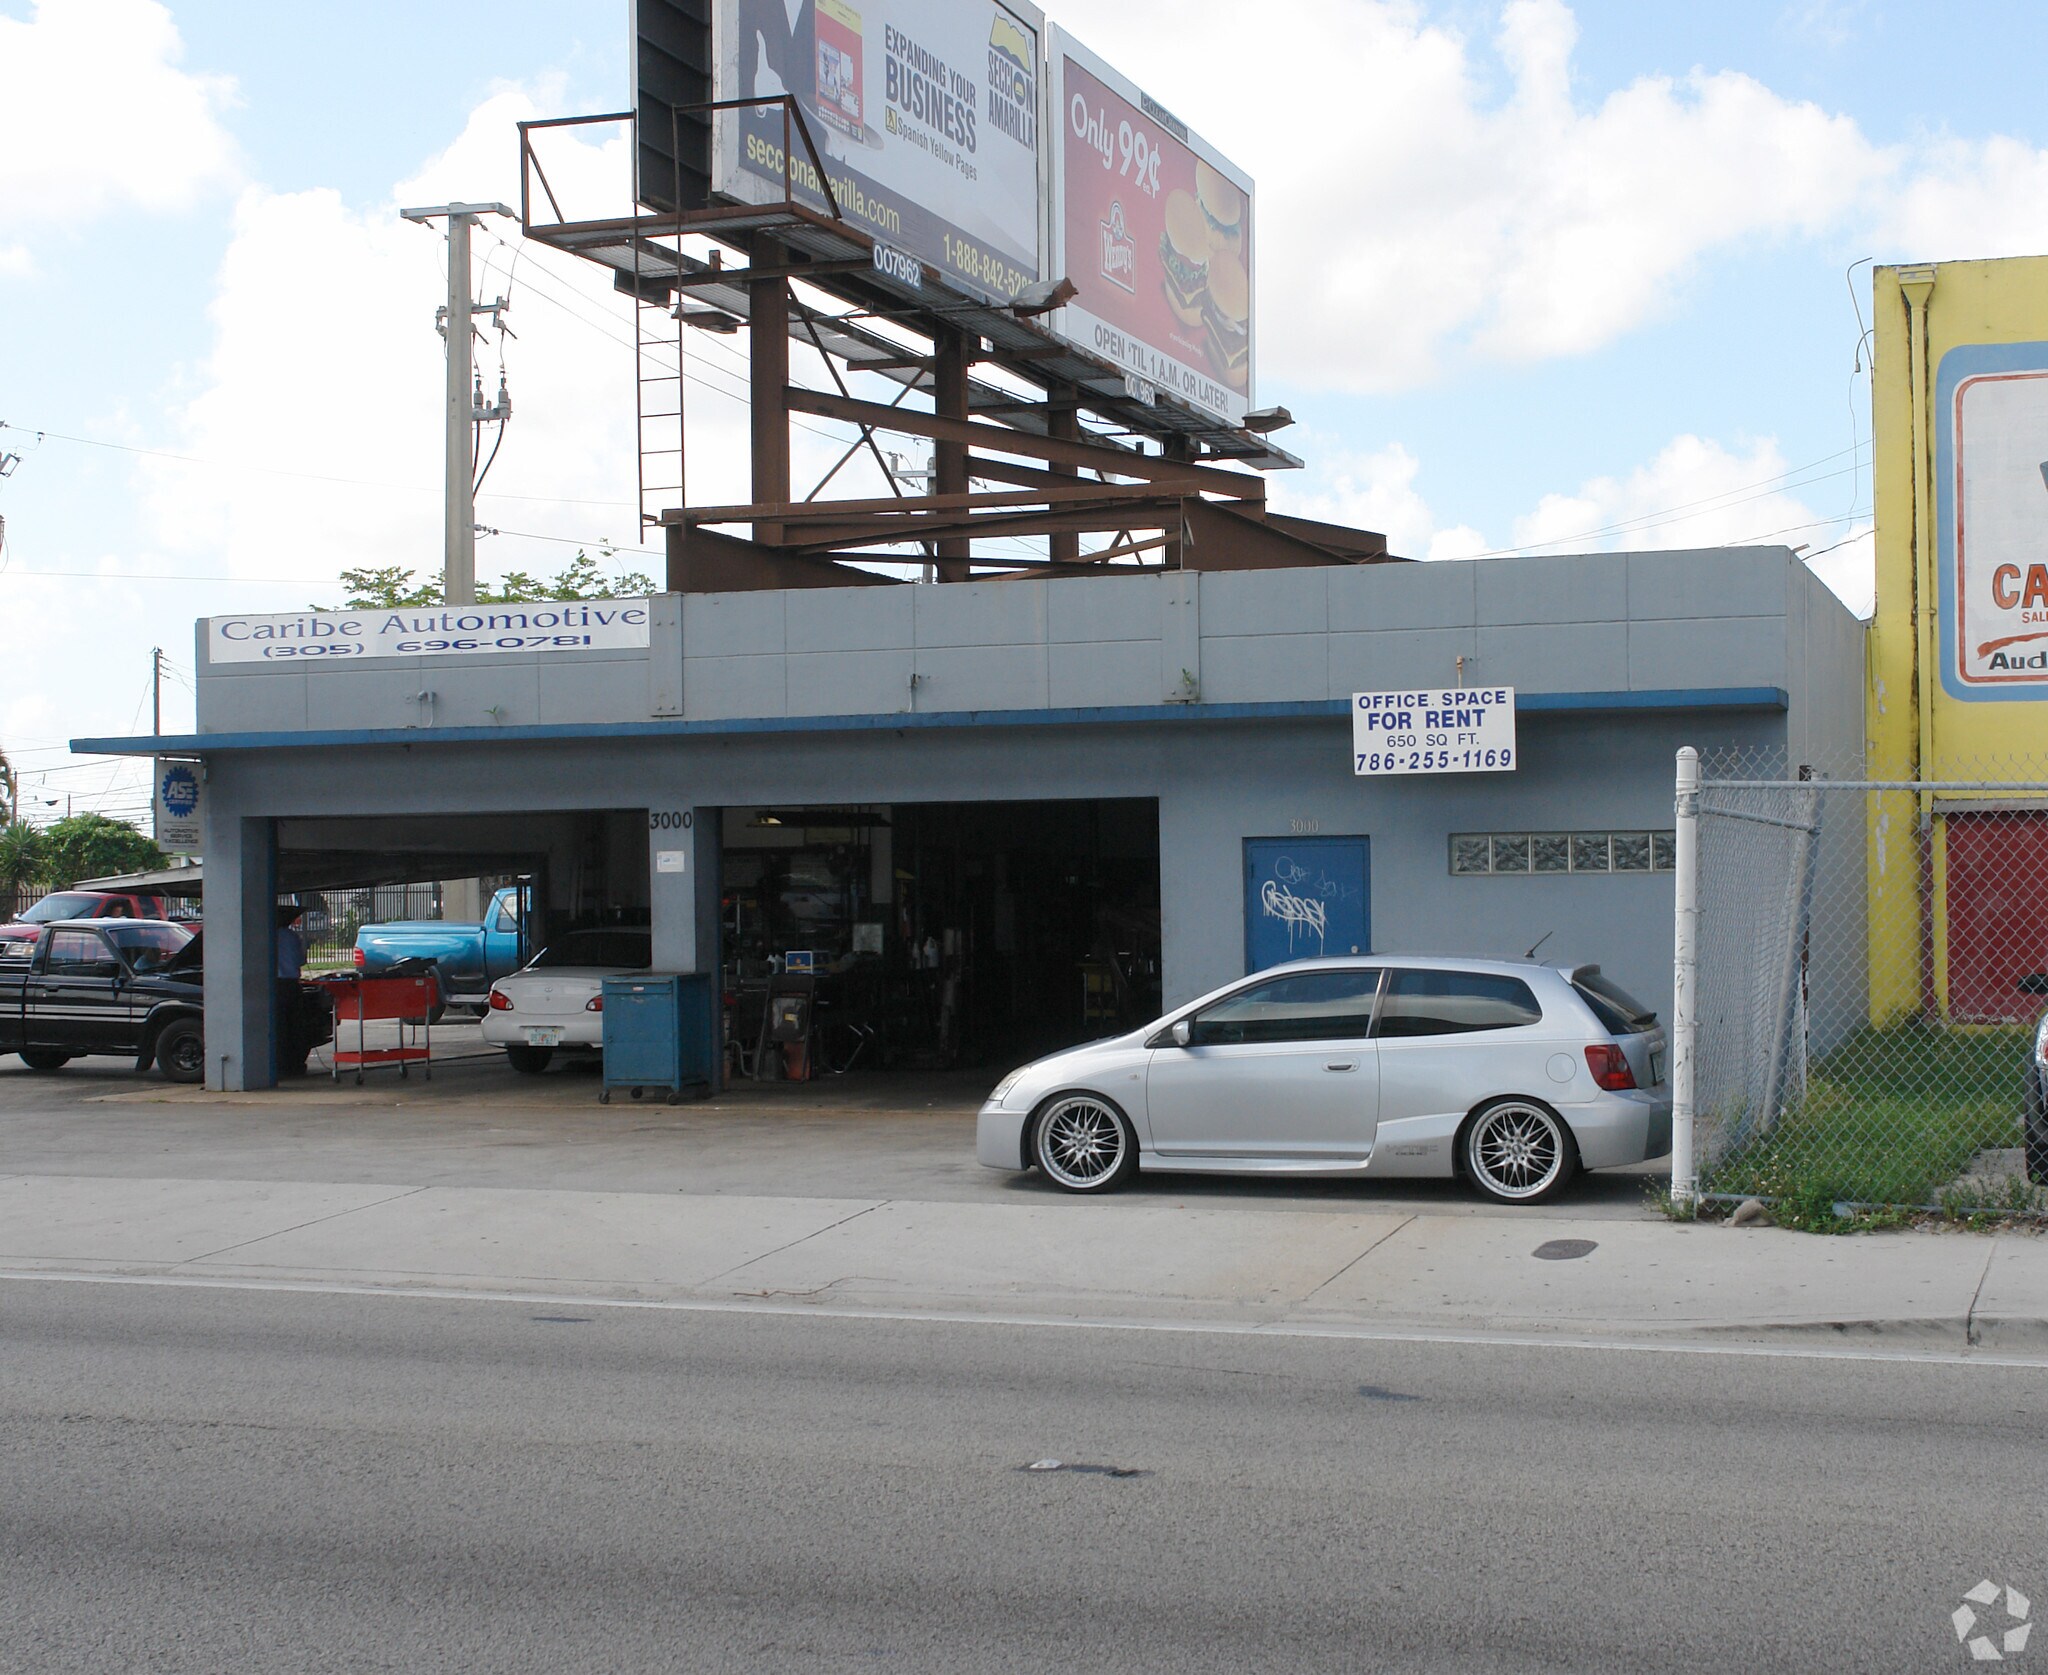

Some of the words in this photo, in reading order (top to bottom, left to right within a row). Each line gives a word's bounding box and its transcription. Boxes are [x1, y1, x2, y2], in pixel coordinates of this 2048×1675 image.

[885, 23, 946, 88] EXPANDING
[949, 68, 976, 109] YOUR
[988, 49, 1033, 114] SECCION
[886, 54, 976, 154] BUSINESS
[989, 89, 1033, 151] AMARILLA
[897, 117, 928, 151] Spanish
[930, 136, 954, 168] Yellow
[956, 153, 977, 181] Pages
[1071, 93, 1114, 170] Only
[1119, 120, 1161, 199] 99¢
[747, 133, 900, 235] secconaarilla.com
[874, 244, 920, 288] 007962
[943, 233, 1033, 297] 1-888-842-52
[1094, 323, 1125, 360] OPEN
[1150, 354, 1155, 375] 1
[1159, 359, 1180, 388] A.M.
[1183, 371, 1196, 397] OR
[1200, 379, 1229, 413] LATER!
[221, 617, 363, 641] Caribe
[379, 606, 646, 635] Automotive
[2022, 611, 2048, 623] SAL
[263, 643, 365, 658] (305)
[396, 635, 590, 652] 696-0781
[1358, 694, 1429, 709] OFFICE
[1442, 690, 1506, 706] SPACE
[1368, 712, 1412, 731] FOR
[1425, 709, 1485, 729] RENT
[1387, 735, 1416, 747] 650
[1426, 734, 1448, 746] SQ
[1458, 733, 1480, 745] FT.
[167, 781, 193, 799] ASE
[650, 811, 692, 829] 3000
[1290, 819, 1319, 832] 3000
